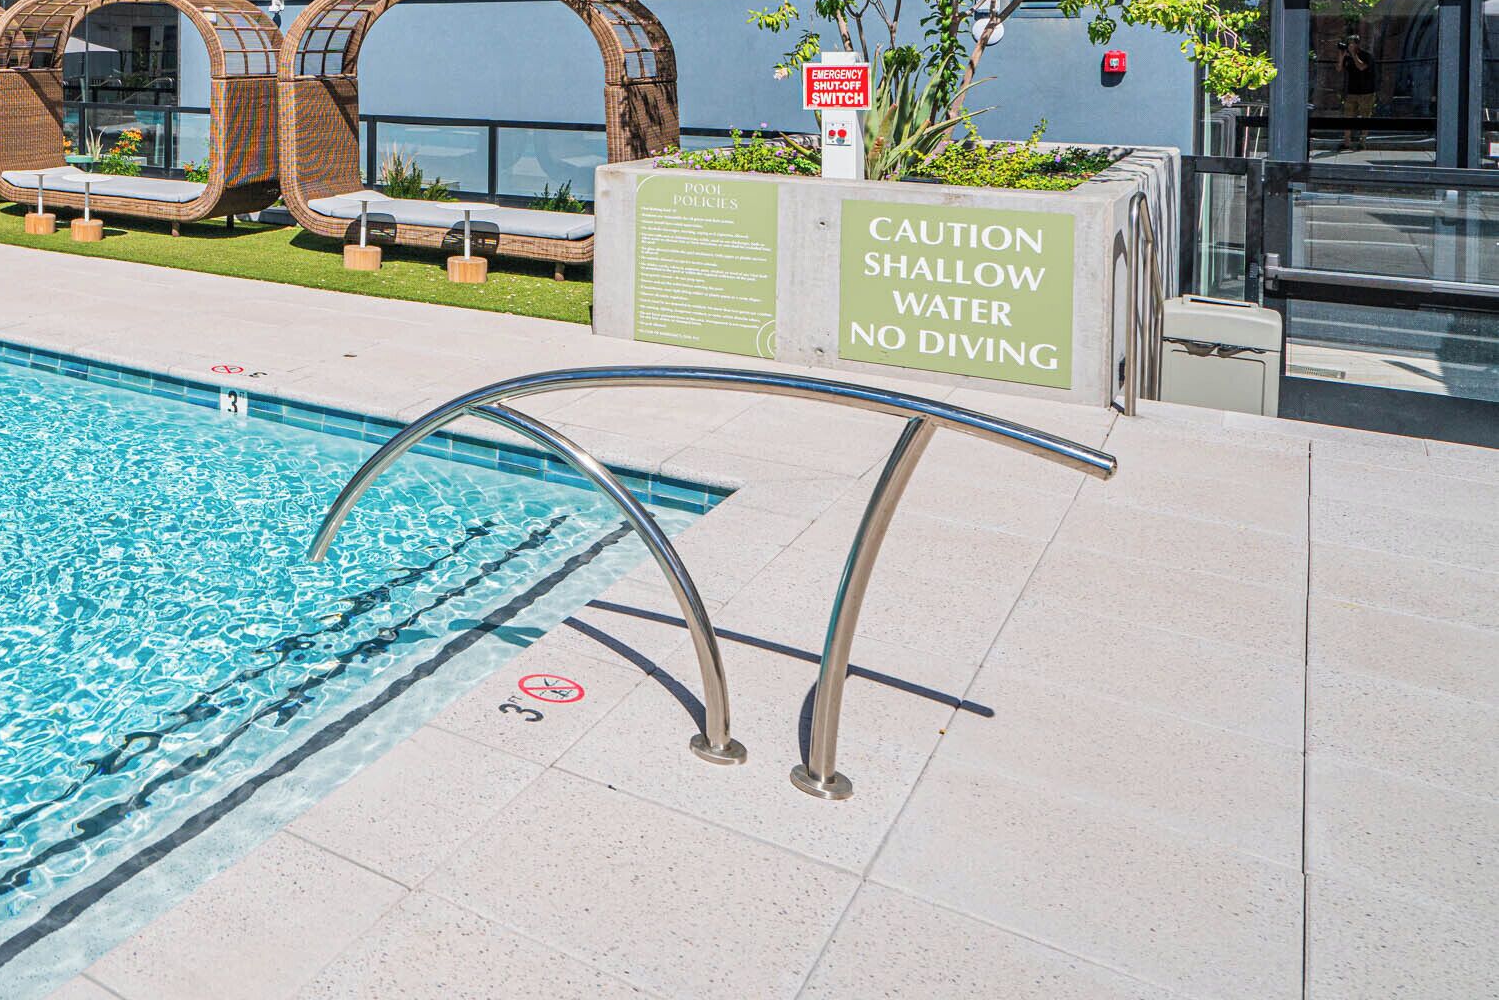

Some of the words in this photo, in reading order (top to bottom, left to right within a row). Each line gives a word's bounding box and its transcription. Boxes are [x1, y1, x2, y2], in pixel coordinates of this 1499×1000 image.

[812, 69, 862, 80] EMERGENCY
[813, 81, 862, 91] SHUT-OFF
[811, 92, 864, 105] SWITCH
[684, 182, 722, 197] POOL
[673, 194, 739, 210] POLICIES
[868, 216, 1044, 254] CAUTION
[863, 252, 1046, 292] SHALLOW
[892, 290, 1012, 327] WATER
[850, 321, 906, 350] NO
[918, 329, 1059, 370] DIVING
[228, 390, 238, 413] 3
[498, 703, 544, 722] 3
